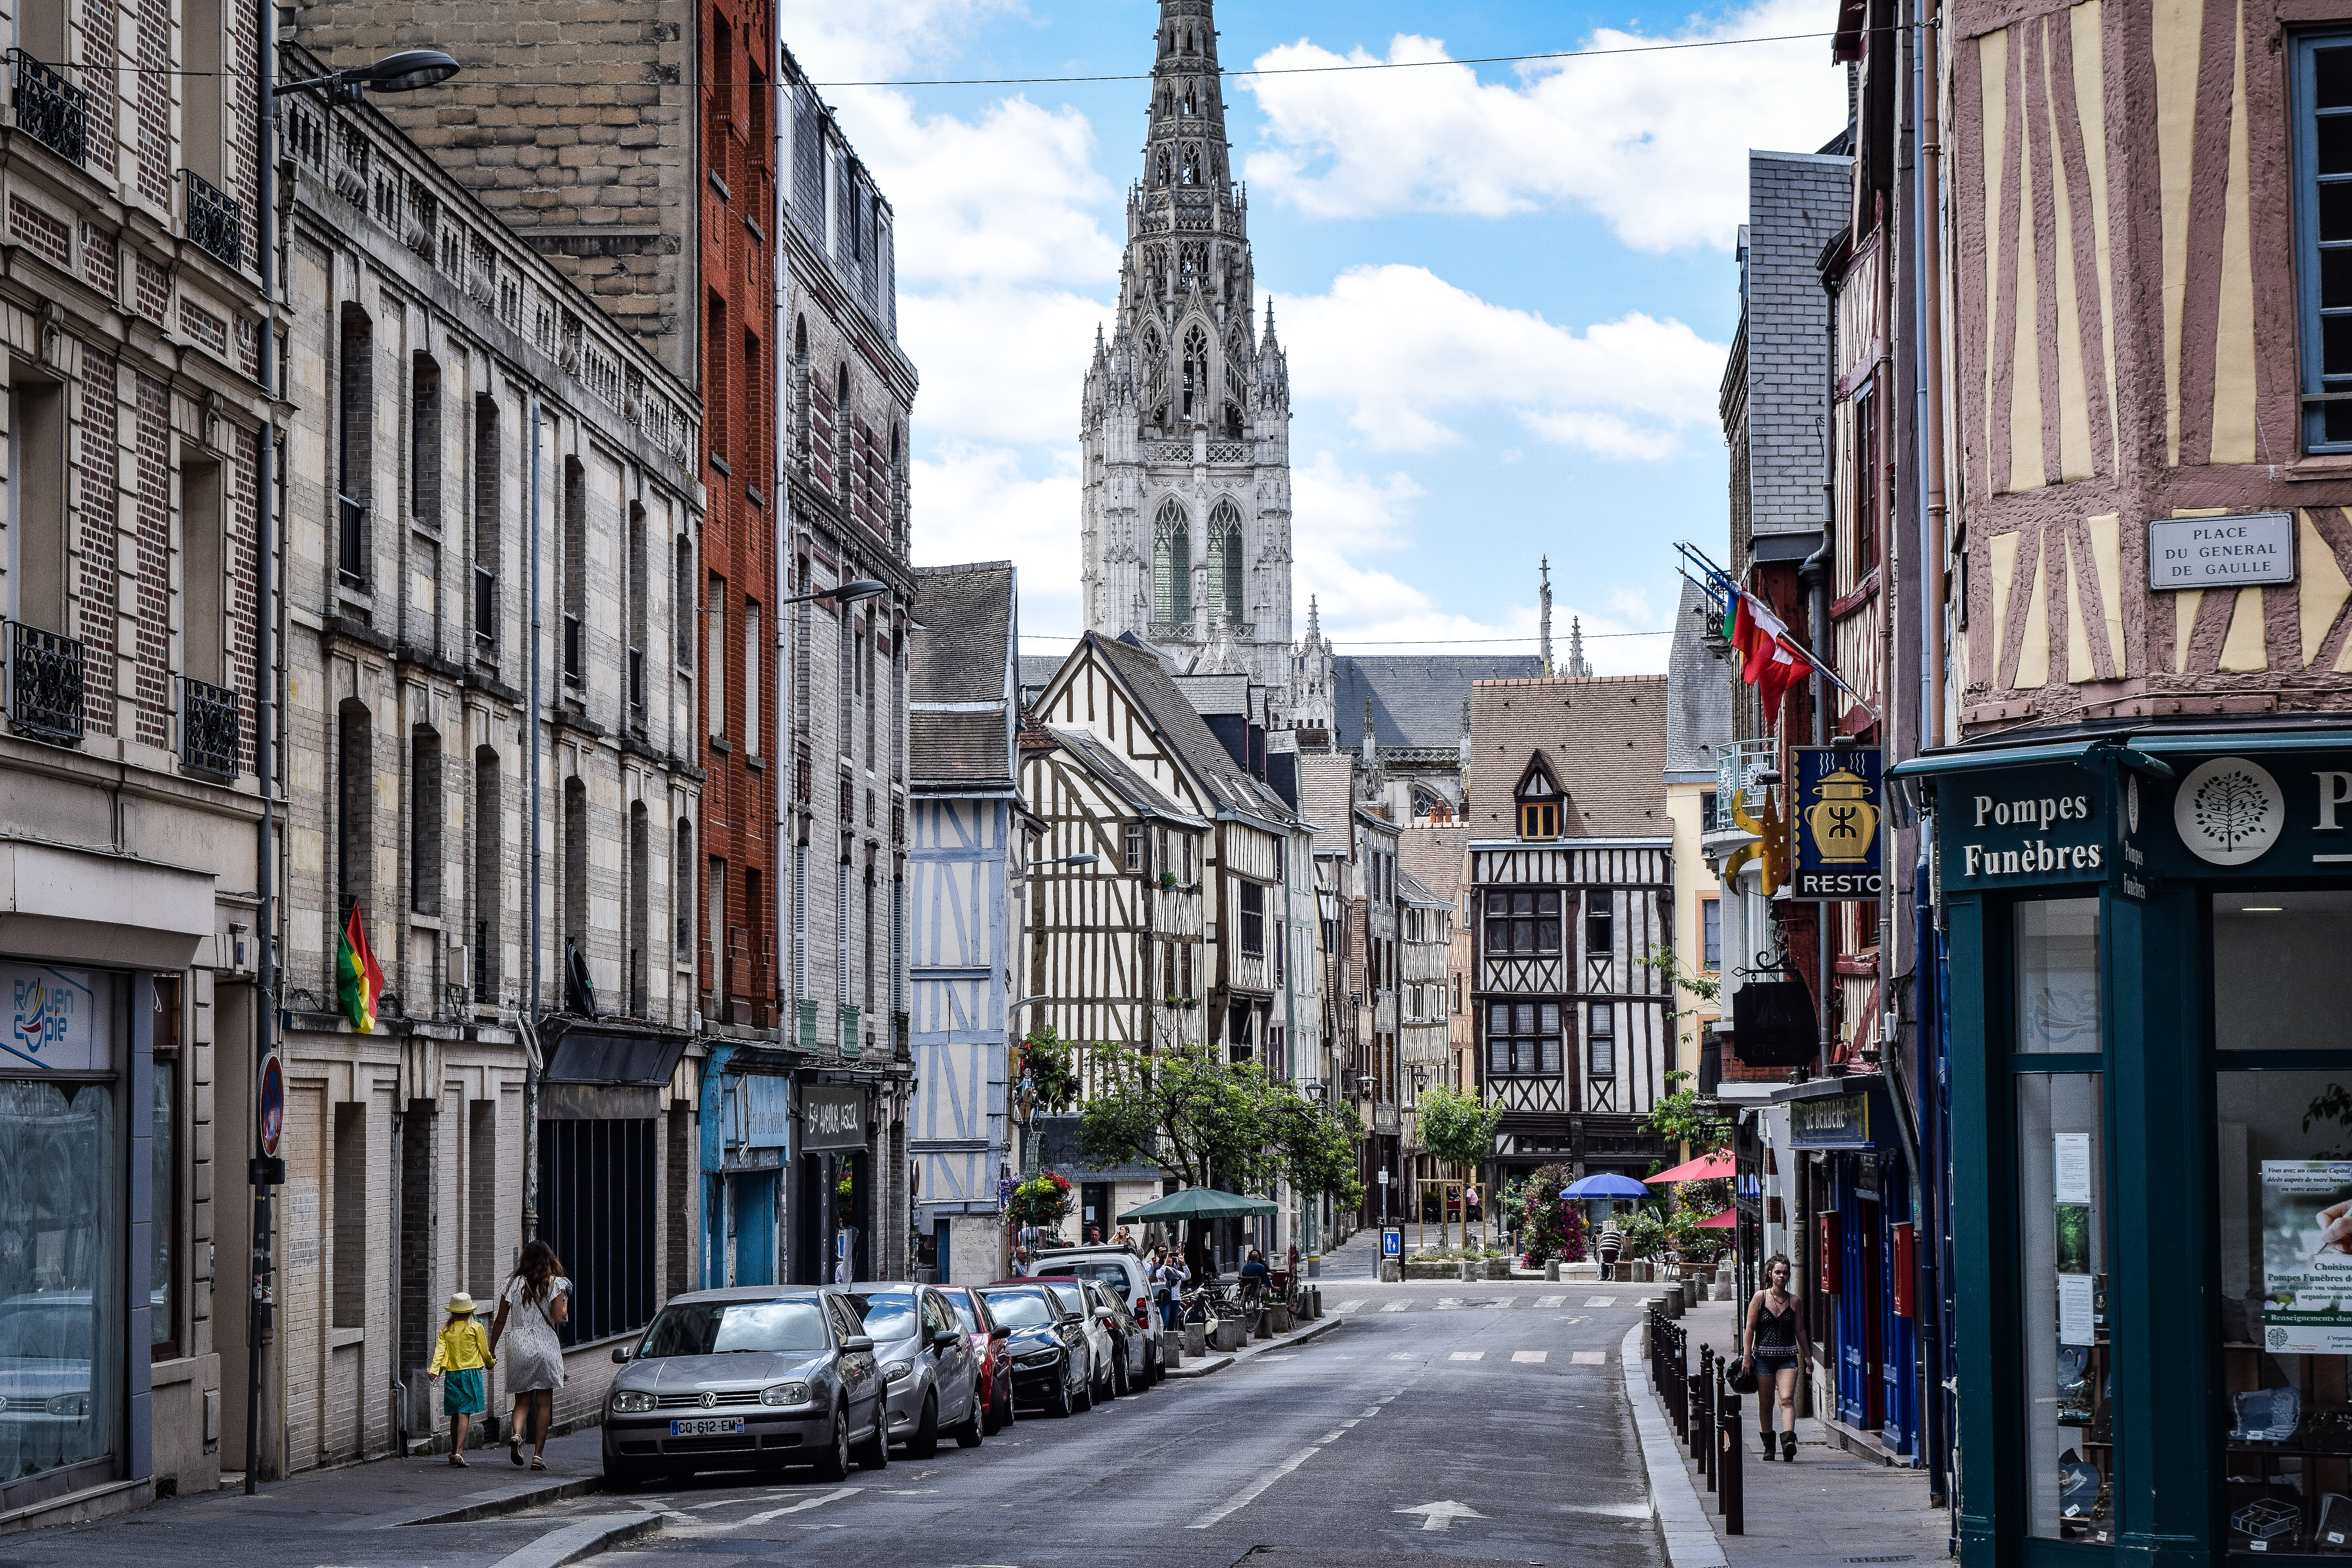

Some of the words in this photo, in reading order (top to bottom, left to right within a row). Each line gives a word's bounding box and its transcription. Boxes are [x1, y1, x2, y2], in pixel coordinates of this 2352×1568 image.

[2194, 527, 2247, 539] PLACE
[2165, 549, 2187, 559] DU
[2200, 544, 2277, 557] GENERAL
[2172, 566, 2192, 577] DE
[2206, 562, 2271, 574] GAULLE
[1974, 796, 2088, 830] Pompes
[1963, 840, 2101, 876] Funèbres
[2125, 840, 2143, 869] Pompes
[1804, 875, 1882, 892] RESTO
[2124, 873, 2145, 898] Funèbres
[759, 1149, 778, 1167] IMAGERIE
[2268, 1274, 2301, 1283] Pompes
